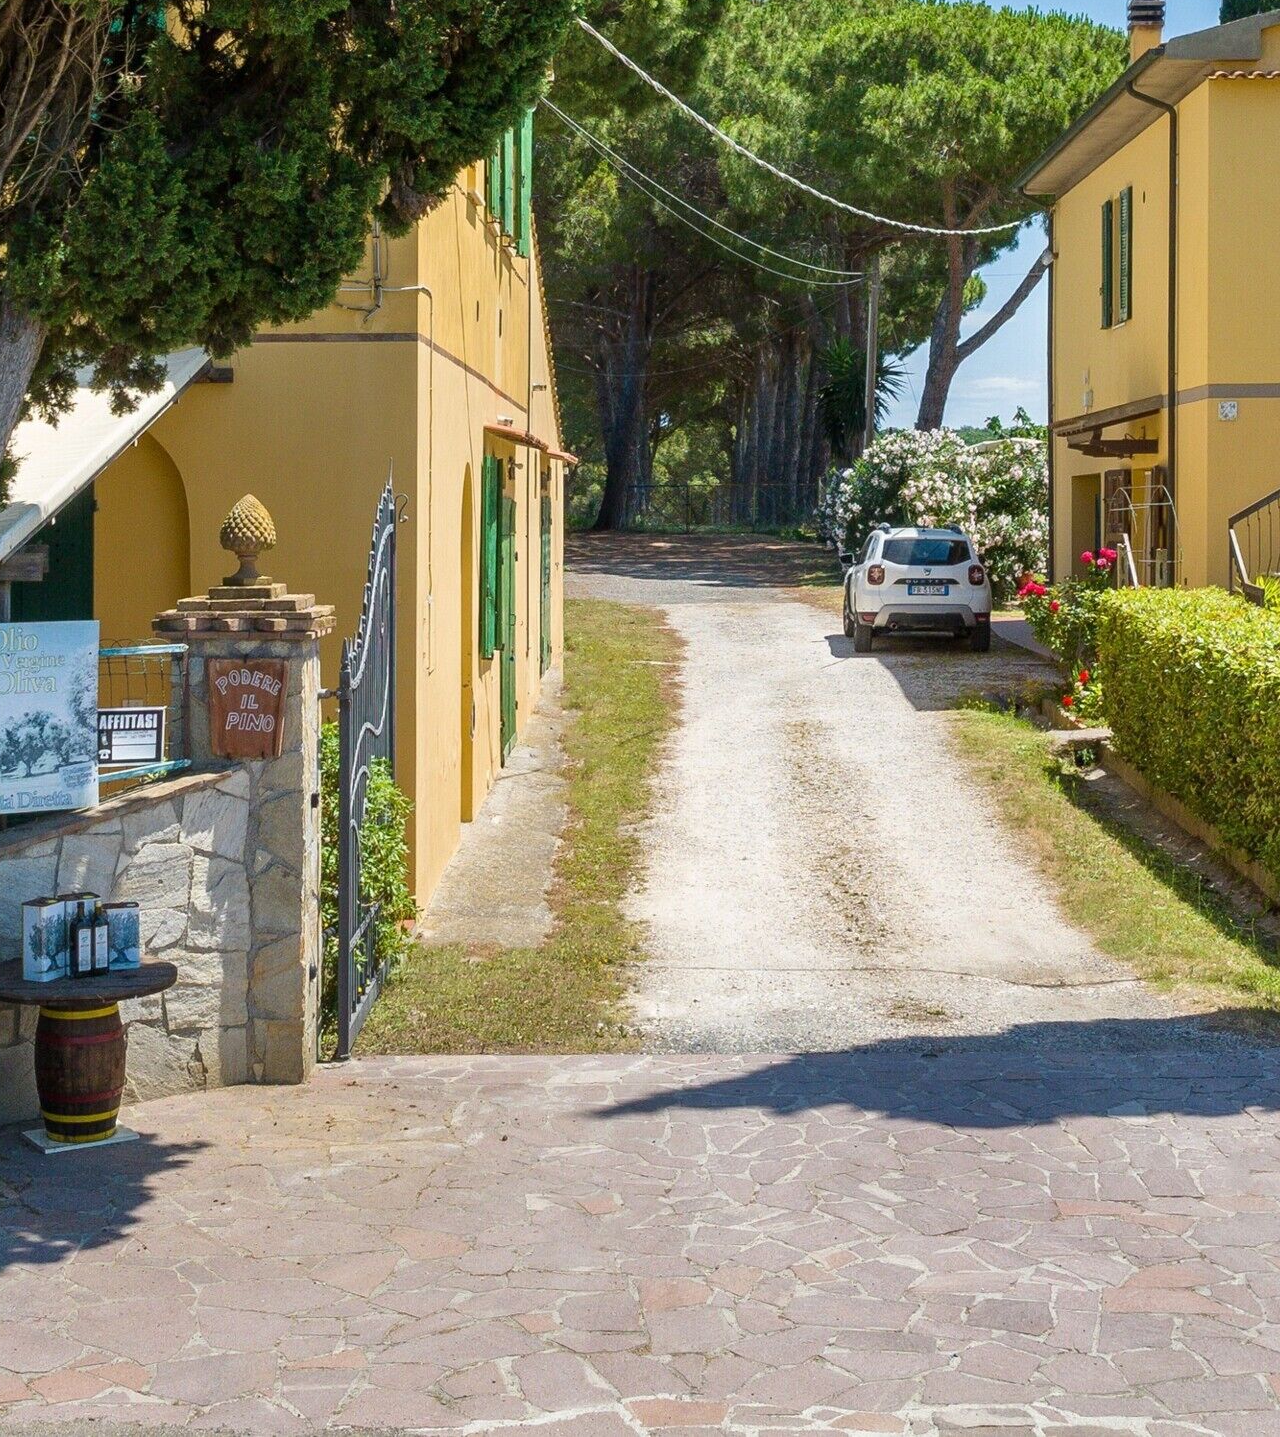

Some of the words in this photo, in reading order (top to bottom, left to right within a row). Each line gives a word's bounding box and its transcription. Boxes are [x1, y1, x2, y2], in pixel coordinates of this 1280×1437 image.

[0, 651, 66, 673] Vergine
[215, 668, 282, 696] PODERE
[240, 694, 259, 709] IL
[99, 713, 158, 730] AFFITTASI
[225, 712, 275, 732] PINO
[16, 790, 73, 809] Diretta
